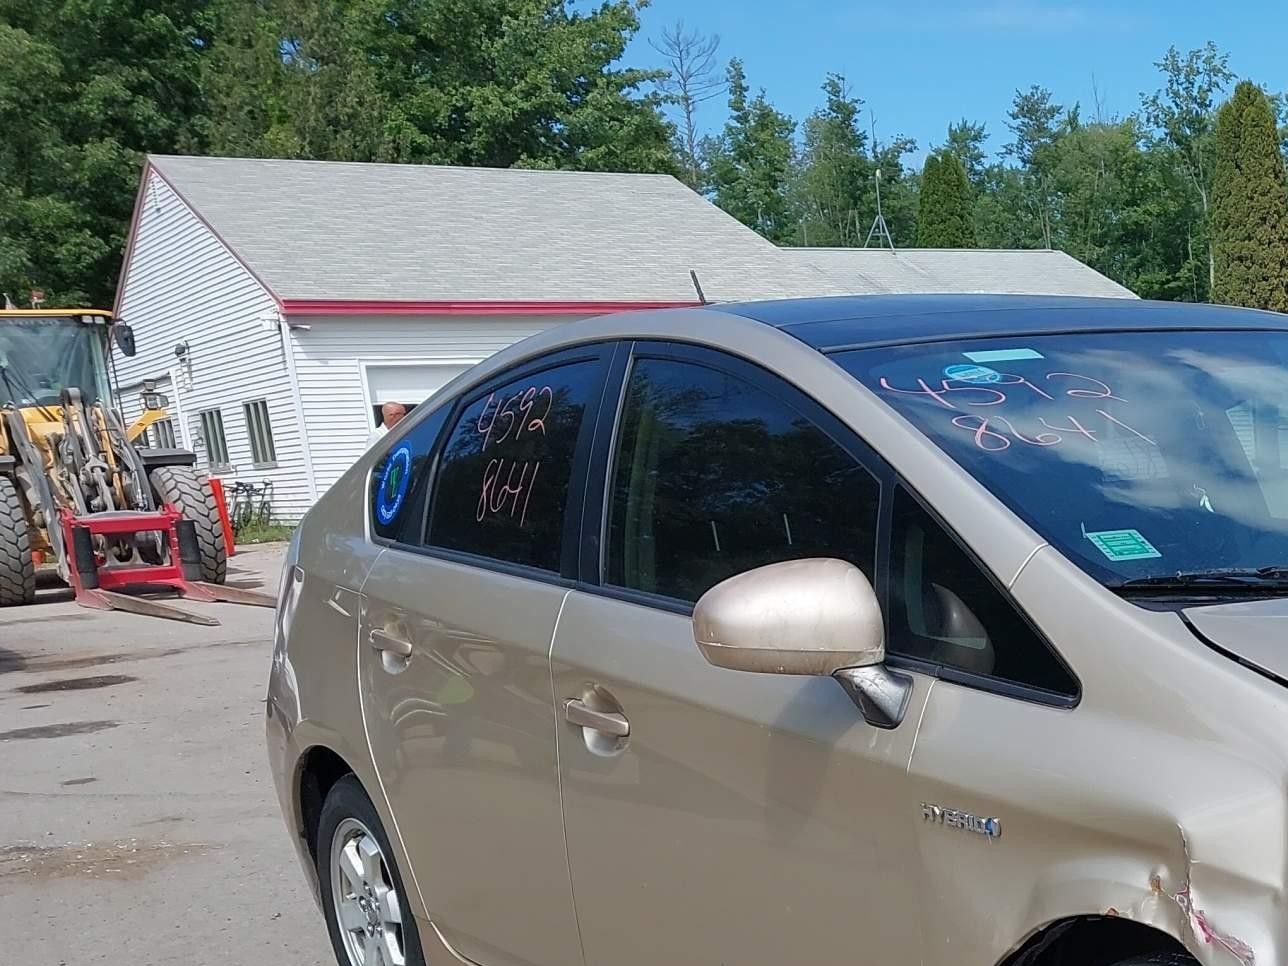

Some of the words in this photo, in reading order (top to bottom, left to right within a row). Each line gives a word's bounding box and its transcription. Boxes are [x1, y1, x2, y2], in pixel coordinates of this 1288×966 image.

[880, 372, 1129, 408] 4592
[477, 386, 553, 452] 4592
[952, 409, 1156, 451] 8641
[476, 458, 540, 527] 8641
